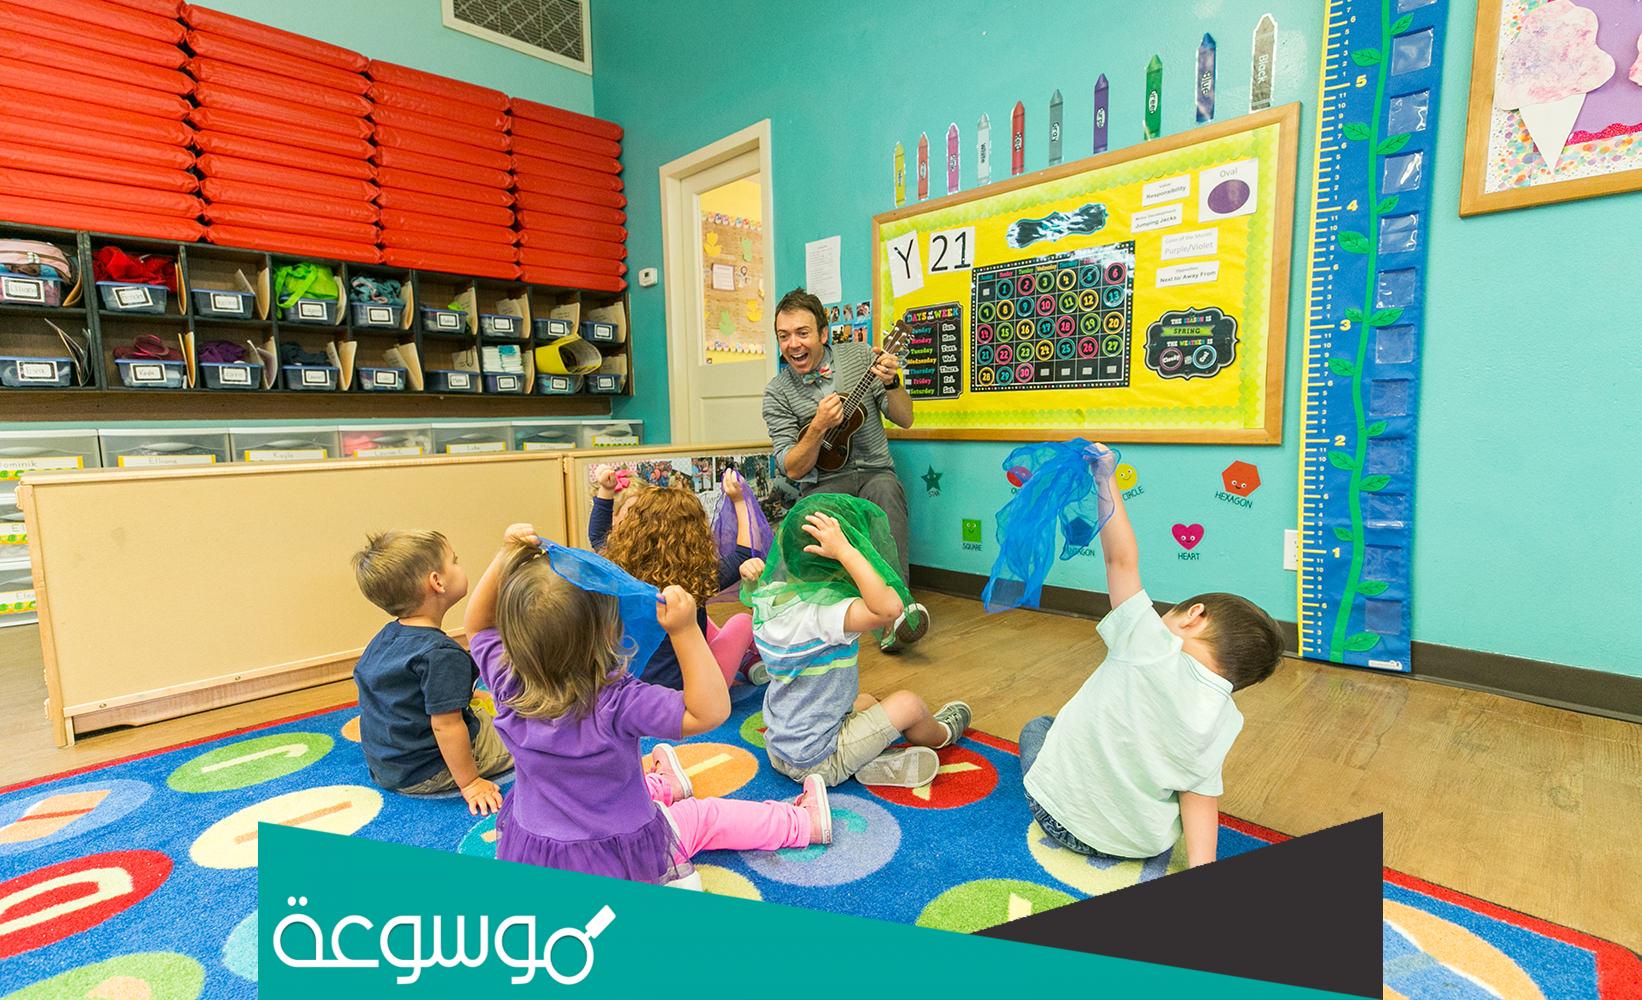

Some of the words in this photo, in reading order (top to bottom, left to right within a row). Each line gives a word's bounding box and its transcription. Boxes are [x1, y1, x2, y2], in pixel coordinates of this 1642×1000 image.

[1256, 53, 1269, 84] Black
[1201, 70, 1212, 96] Blue
[1355, 74, 1368, 88] 5
[1219, 167, 1238, 178] Oval
[1146, 185, 1186, 200] Responsibility
[1346, 199, 1358, 212] 4
[1135, 218, 1159, 229] Jumping
[1160, 215, 1177, 224] Jacks
[931, 231, 972, 272] 21
[1164, 241, 1214, 255] Purple/Violet
[894, 238, 914, 279] Y
[1002, 284, 1007, 294] 1
[1023, 280, 1030, 290] 2
[1042, 277, 1048, 287] 3
[1063, 275, 1070, 285] 4
[1112, 268, 1119, 278] 6
[983, 308, 990, 317] 7
[1002, 305, 1008, 314] 8
[1022, 302, 1028, 311] 9
[1041, 300, 1051, 310] 10
[1064, 296, 1074, 308] 11
[1083, 295, 1094, 307] 12
[1108, 290, 1120, 303] 13
[906, 312, 927, 322] DAYS
[934, 307, 959, 318] WEEK
[1001, 328, 1010, 337] 15
[1020, 325, 1030, 335] 16
[1041, 322, 1051, 333] 17
[1060, 321, 1071, 332] 18
[1085, 318, 1096, 330] 19
[1108, 317, 1120, 328] 20
[1339, 319, 1351, 331] 3
[981, 350, 990, 360] 21
[999, 350, 1009, 360] 22
[1020, 347, 1030, 357] 23
[1040, 345, 1050, 356] 24
[1061, 344, 1071, 354] 25
[1082, 343, 1093, 353] 26
[1107, 340, 1119, 352] 27
[982, 372, 991, 381] 28
[1000, 371, 1010, 381] 29
[1020, 368, 1030, 378] 30
[1334, 435, 1346, 446] 2
[0, 459, 38, 468] ominik
[1122, 486, 1145, 502] CIRCLE
[1214, 490, 1253, 509] HEXAGON
[962, 542, 983, 552] SQUARE
[1332, 547, 1340, 558] 1
[1177, 552, 1200, 561] HEART
